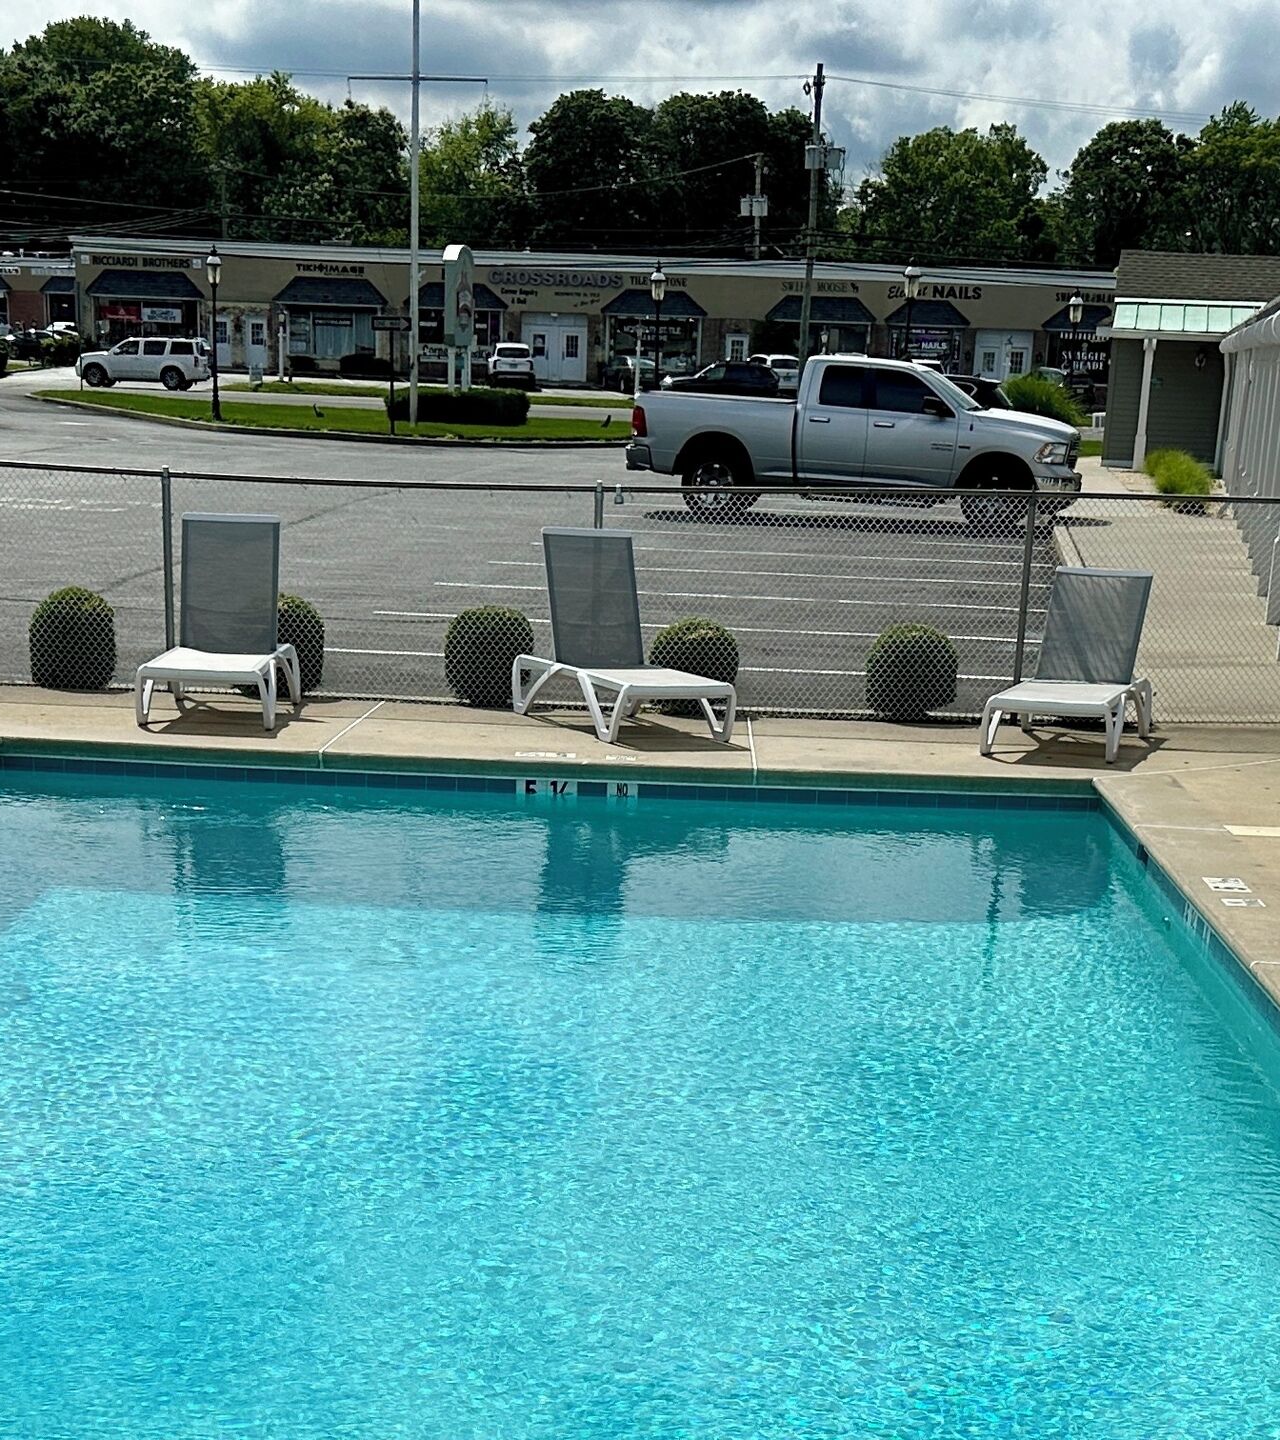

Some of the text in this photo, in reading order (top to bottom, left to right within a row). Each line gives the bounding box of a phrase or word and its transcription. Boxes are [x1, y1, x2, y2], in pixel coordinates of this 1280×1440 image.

[92, 255, 191, 269] RICCIARDI BROTHERS
[488, 268, 624, 289] CROSSROADS
[630, 275, 648, 286] TILE
[932, 285, 982, 300] NAILS
[921, 341, 948, 350] NAILS
[616, 782, 629, 798] NO
